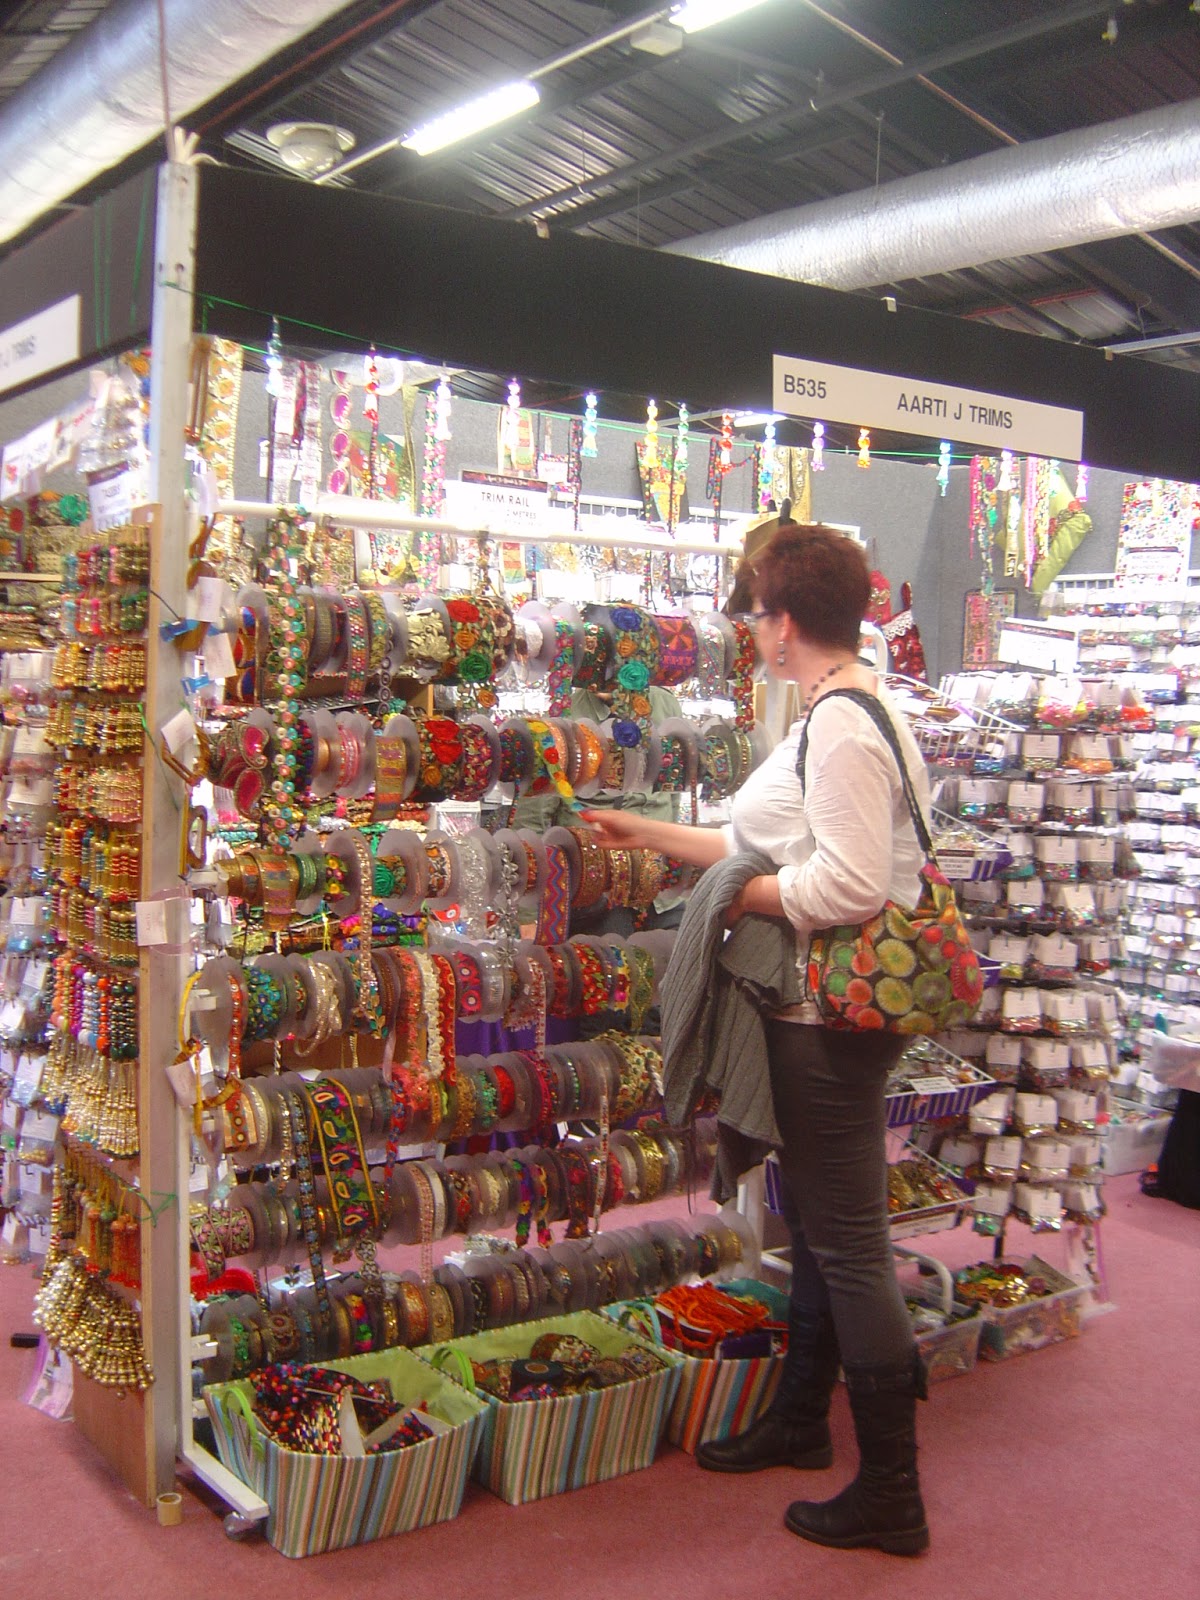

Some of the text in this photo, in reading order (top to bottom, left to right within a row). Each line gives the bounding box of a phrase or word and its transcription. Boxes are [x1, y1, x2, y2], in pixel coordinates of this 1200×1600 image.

[784, 374, 827, 399] B535
[897, 393, 1013, 429] AARTI J TRIMS
[481, 491, 530, 508] TRIM RAIL
[512, 510, 537, 520] METRES
